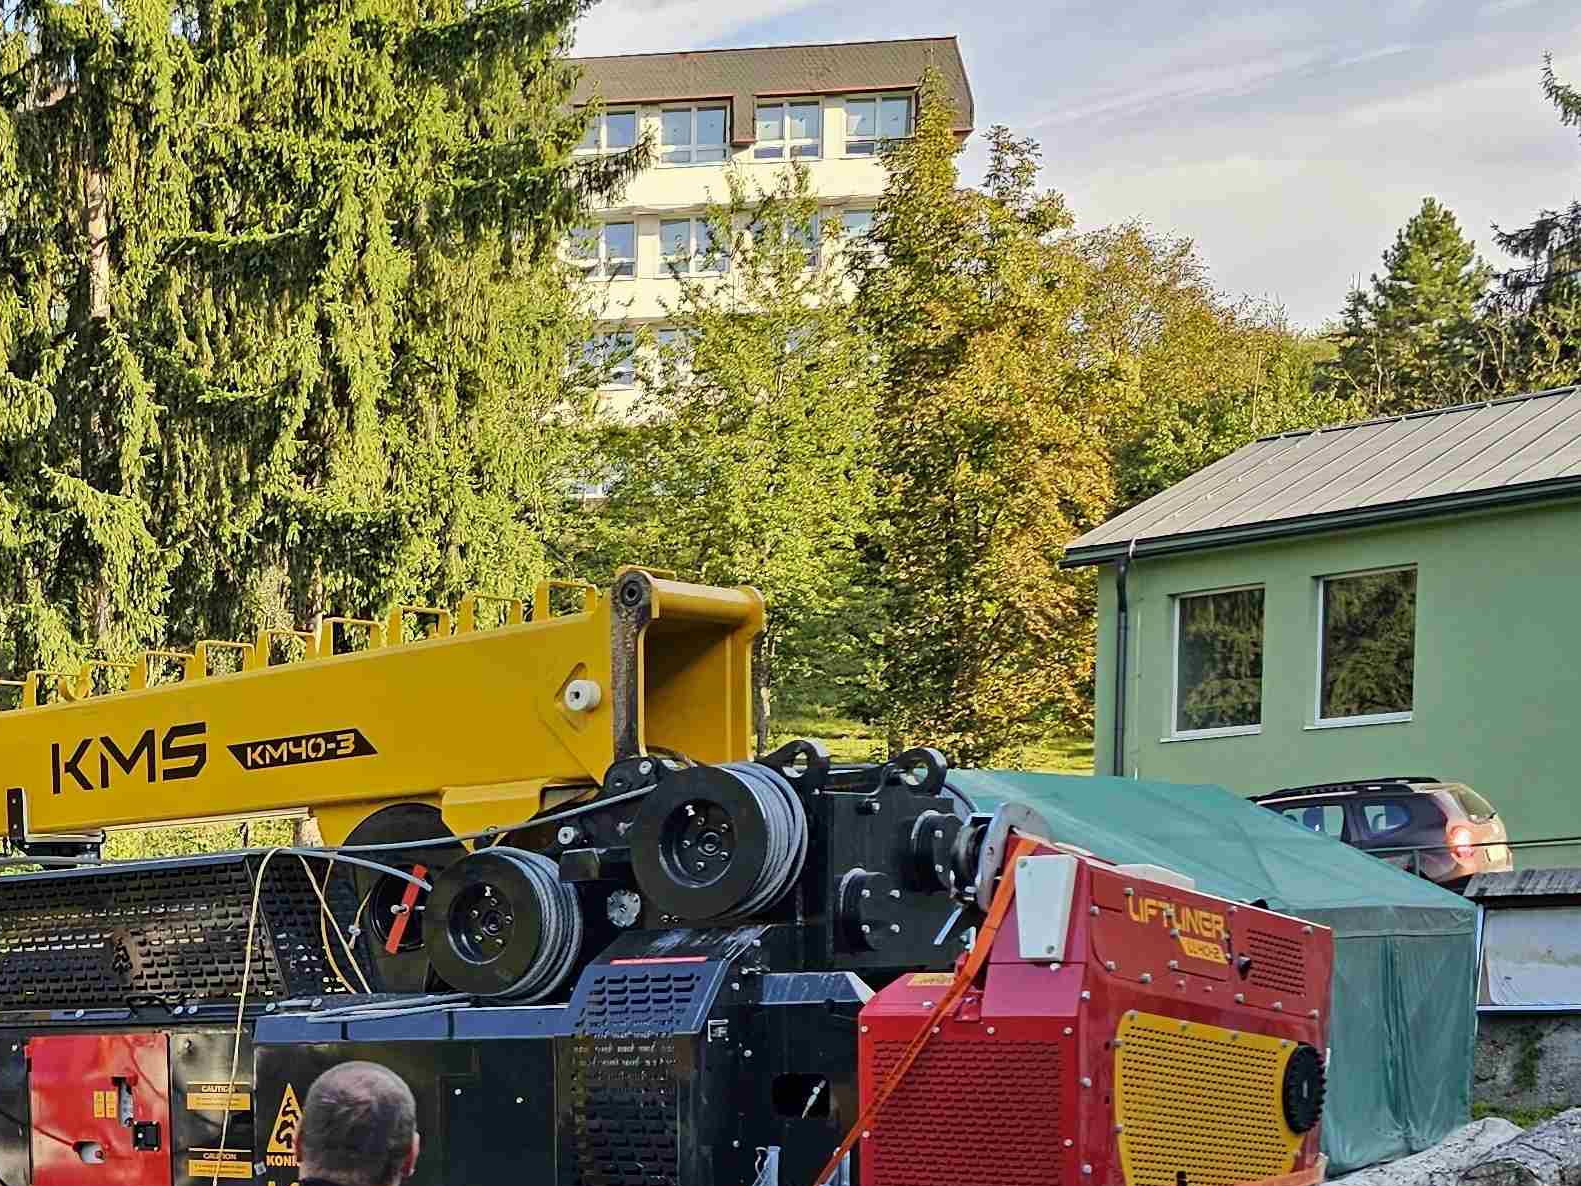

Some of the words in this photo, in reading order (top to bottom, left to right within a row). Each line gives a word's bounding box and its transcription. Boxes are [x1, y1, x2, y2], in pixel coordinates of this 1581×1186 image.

[51, 721, 207, 795] KMS
[246, 732, 356, 768] KM40-3
[202, 1152, 237, 1160] CAUION
